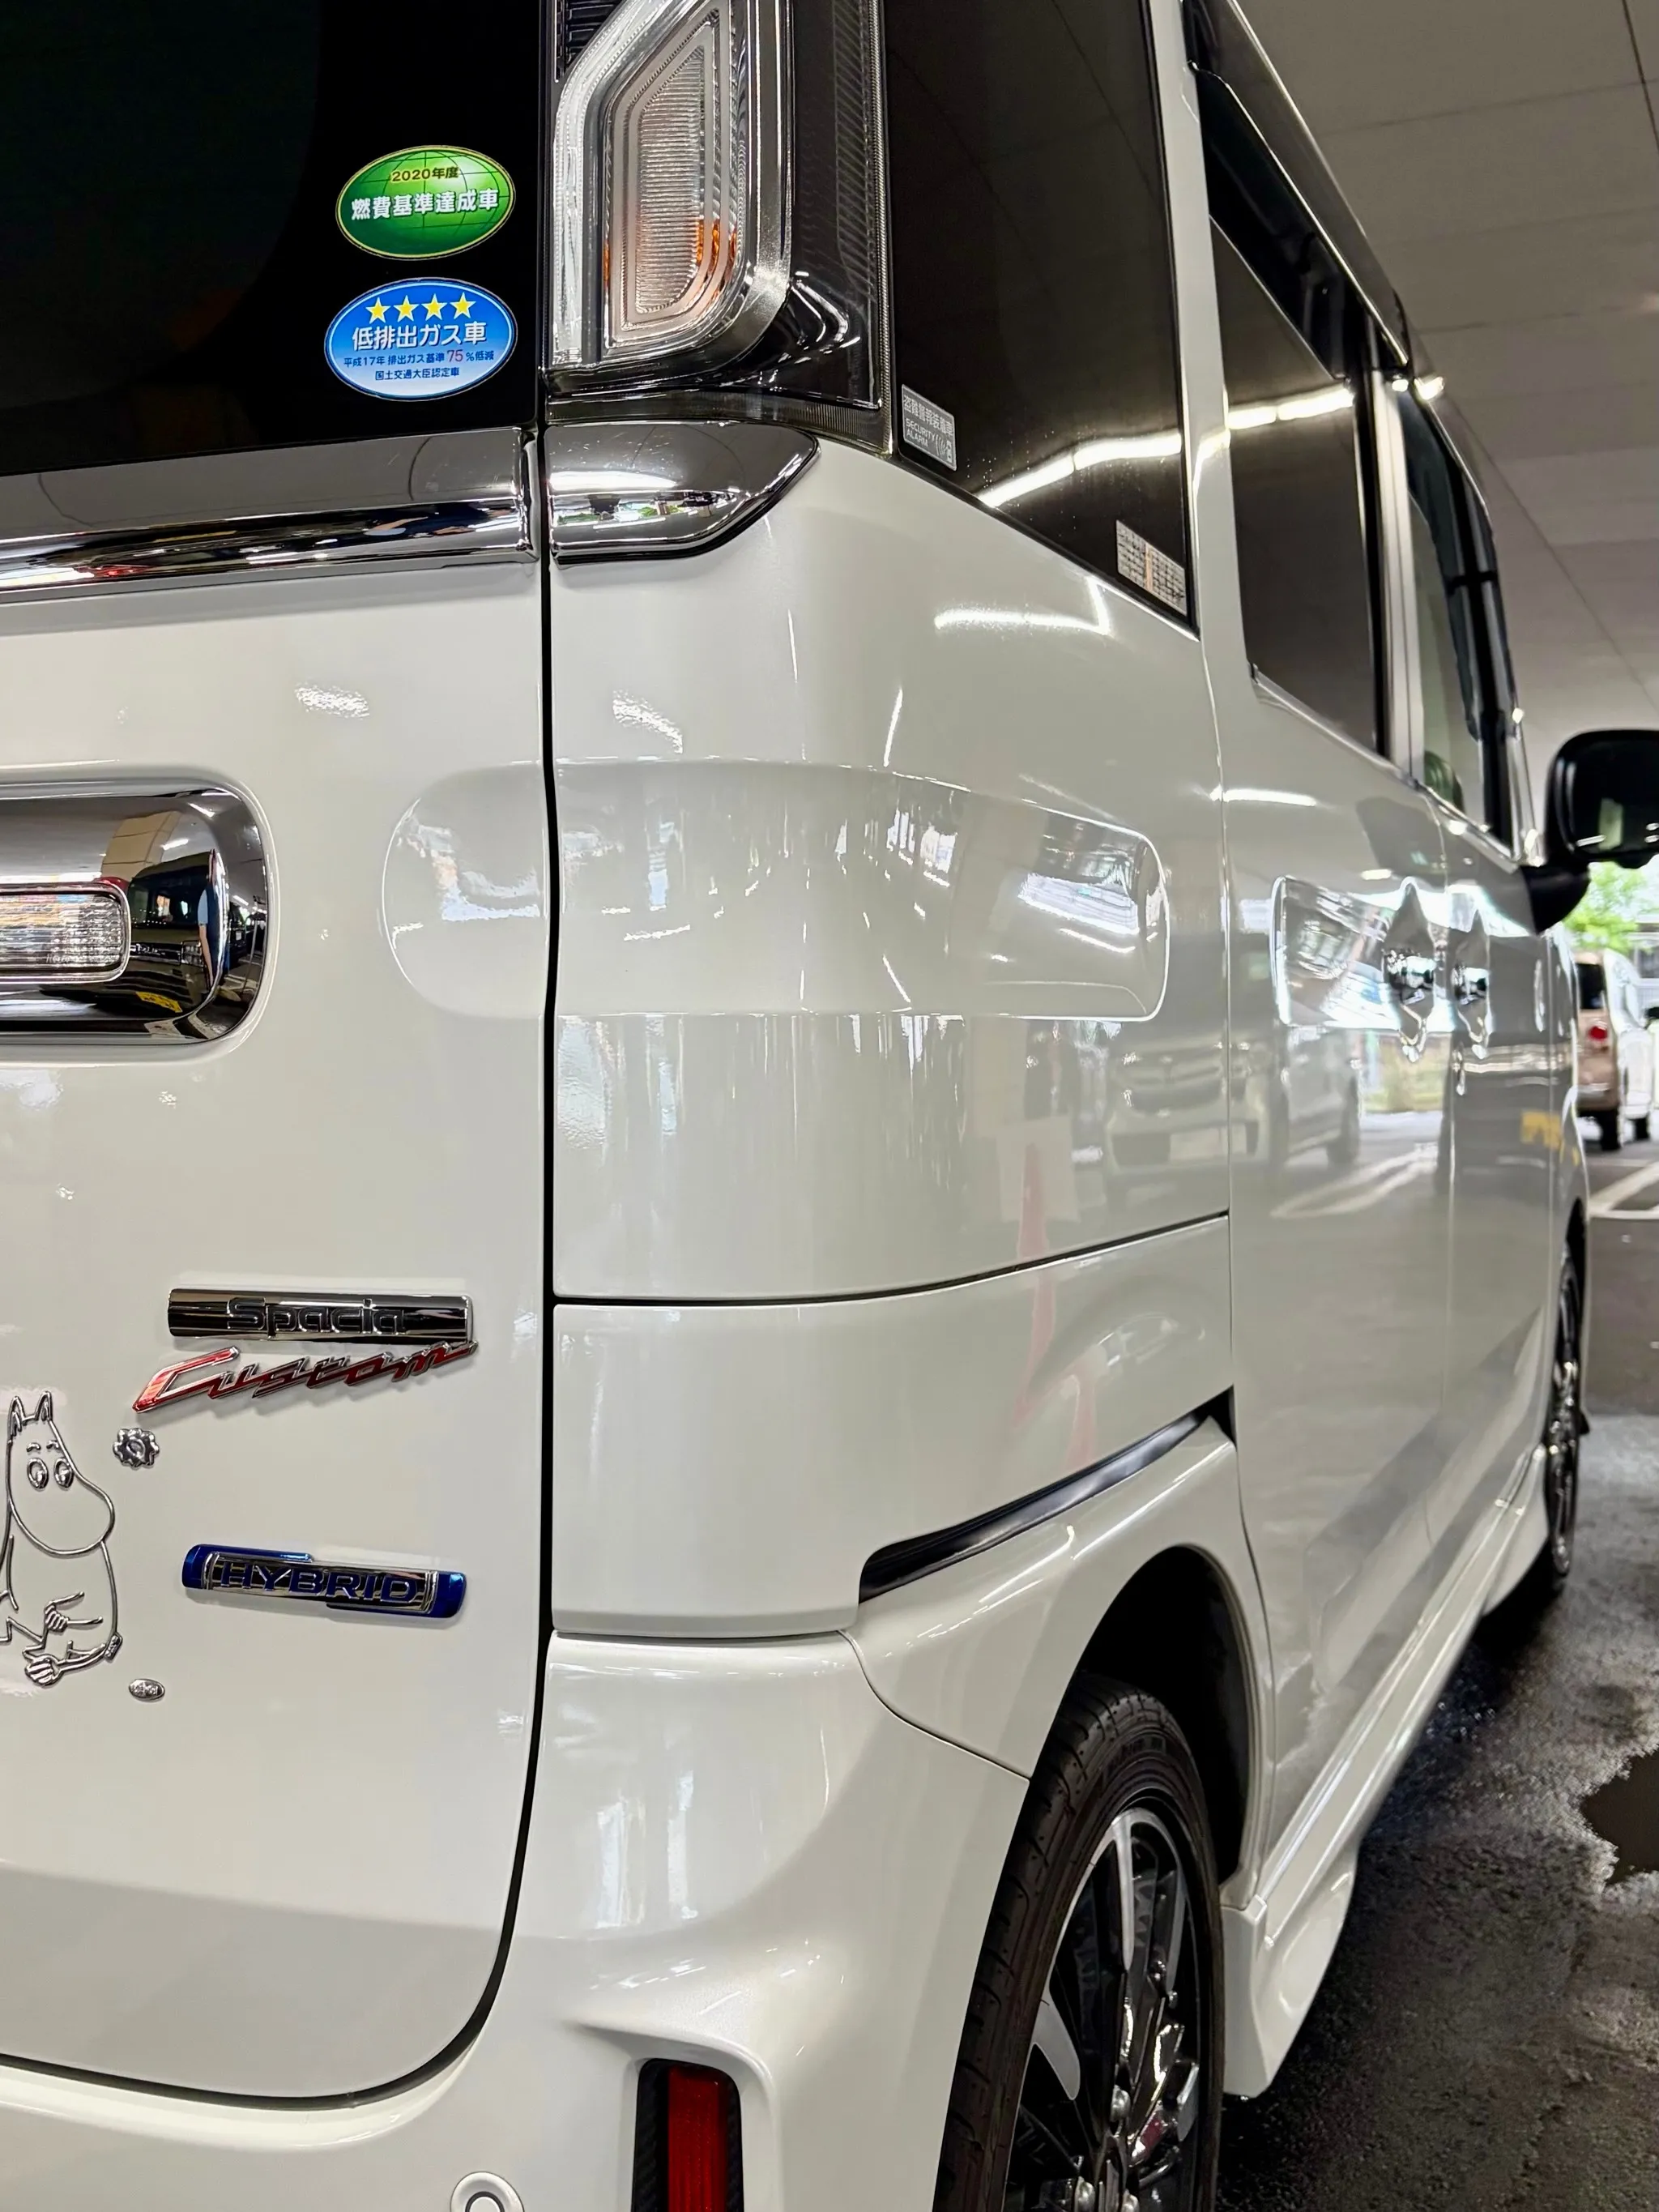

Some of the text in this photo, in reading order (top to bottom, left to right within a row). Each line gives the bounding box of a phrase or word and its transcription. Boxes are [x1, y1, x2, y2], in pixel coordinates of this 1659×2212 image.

[392, 166, 460, 182] 2020年度
[351, 188, 499, 220] 燃費基準達成車
[352, 321, 487, 352] 低排出ガス車
[375, 367, 460, 381] 国土交通大臣認定車
[906, 417, 936, 442] SECURITY
[906, 429, 928, 448] ALARM
[226, 1296, 406, 1340] Spacia
[131, 1340, 480, 1413] Custom
[220, 1563, 420, 1604] HYBRID
